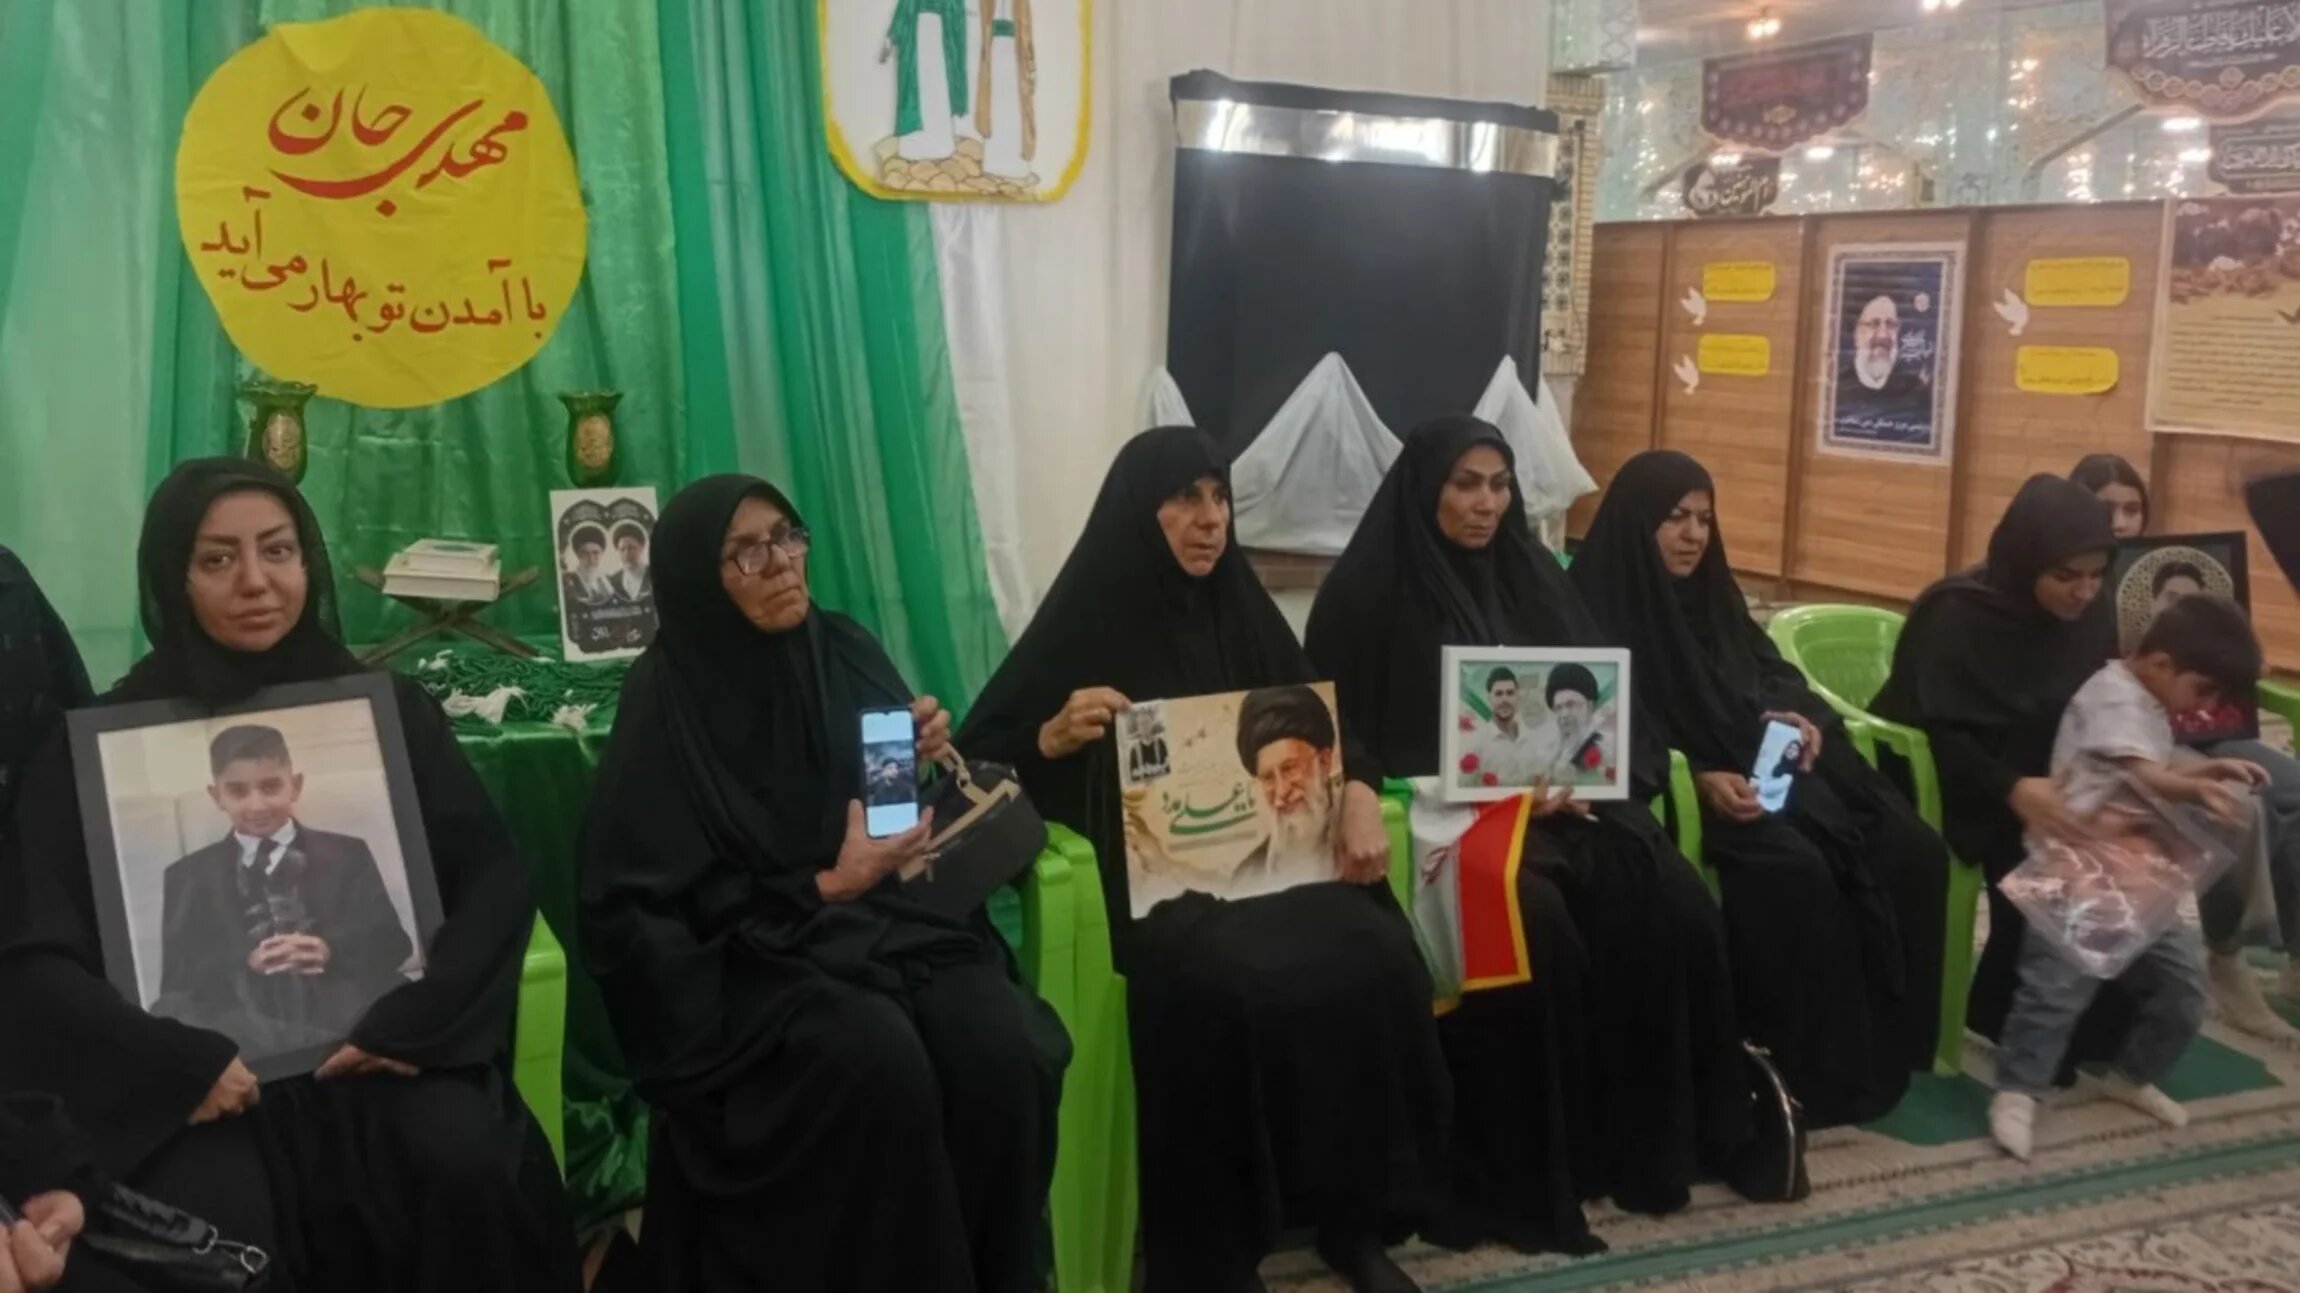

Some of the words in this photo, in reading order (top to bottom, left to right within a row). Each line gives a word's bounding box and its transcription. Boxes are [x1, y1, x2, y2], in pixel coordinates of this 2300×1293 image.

[268, 98, 529, 201] مهدی
[268, 85, 414, 217] جان
[286, 258, 368, 342] بهار
[365, 283, 406, 334] تو
[409, 259, 514, 333] آمدن
[521, 277, 547, 339] با
